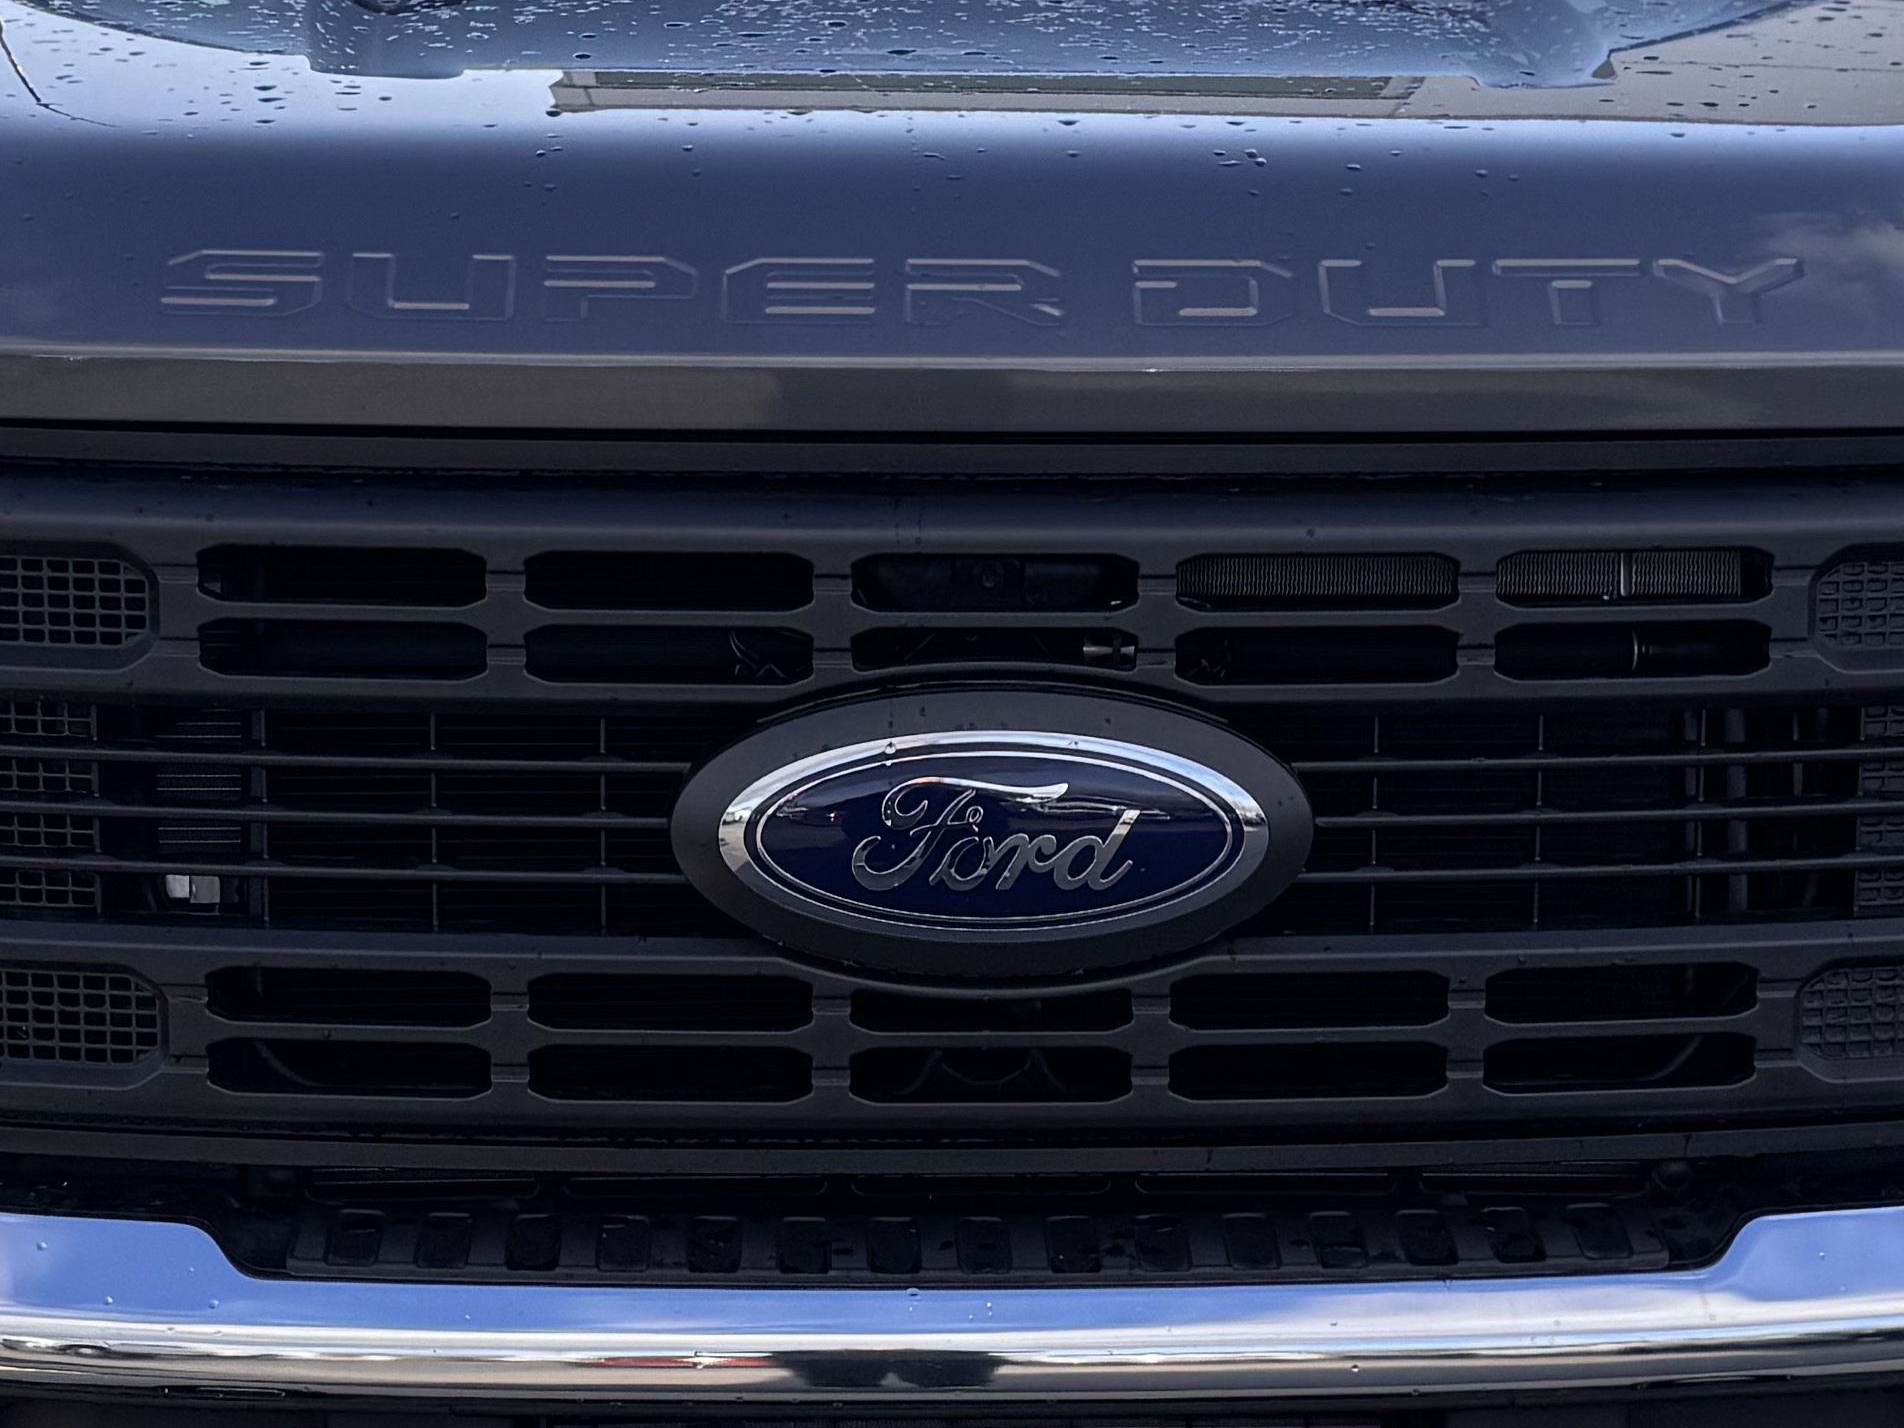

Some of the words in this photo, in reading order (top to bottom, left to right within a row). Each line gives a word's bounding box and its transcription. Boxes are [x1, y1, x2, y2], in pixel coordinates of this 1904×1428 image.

[158, 249, 1069, 327] SUPER
[1130, 254, 1808, 332] DUTY
[851, 775, 1136, 892] Ford
